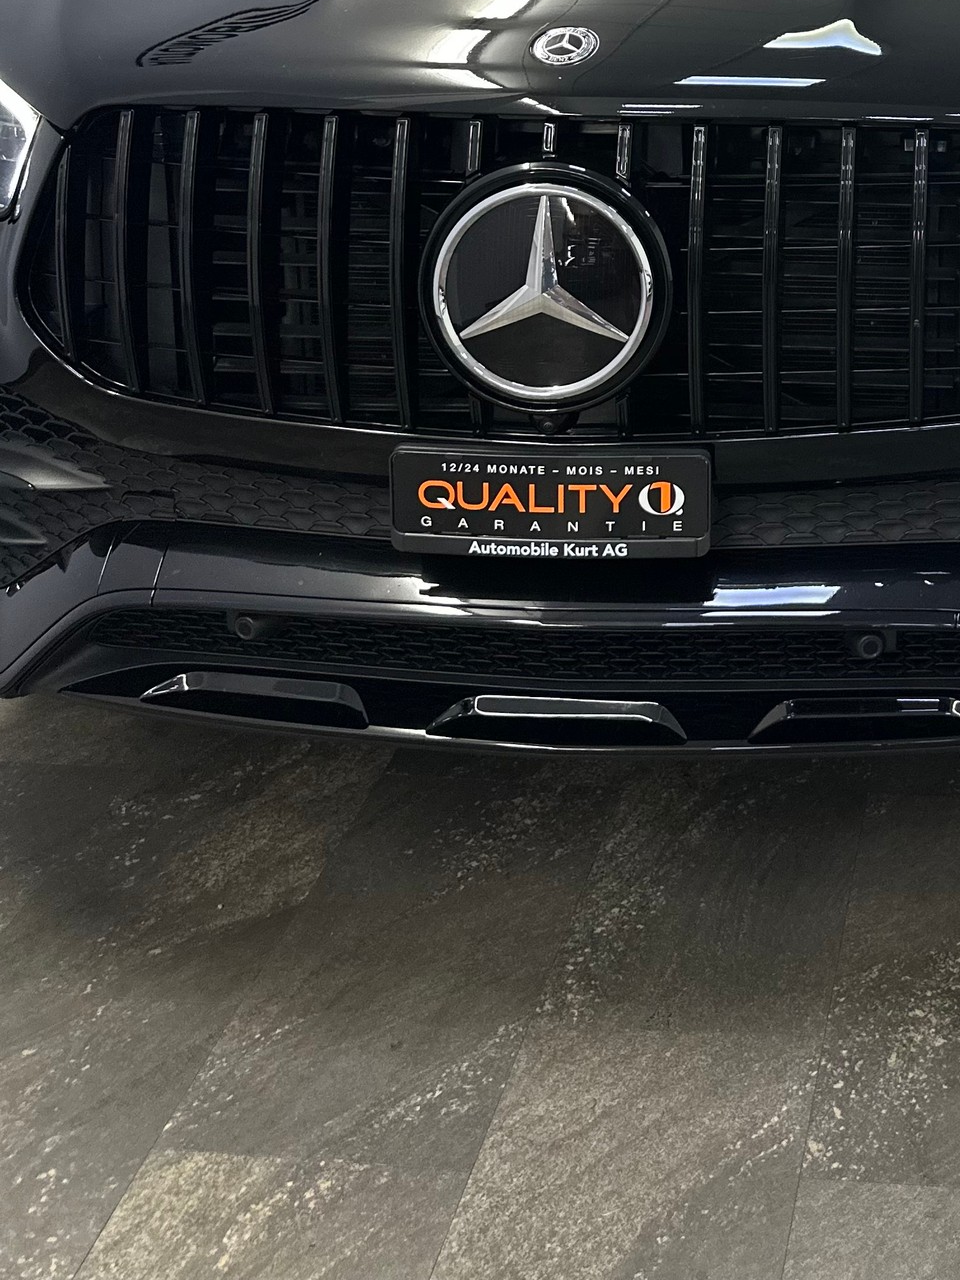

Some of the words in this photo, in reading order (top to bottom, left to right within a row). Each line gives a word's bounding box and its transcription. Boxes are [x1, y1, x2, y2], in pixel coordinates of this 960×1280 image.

[441, 463, 480, 473] 12/24
[487, 464, 546, 475] MONATE
[566, 466, 603, 475] MOIS
[624, 466, 660, 475] MESI
[418, 480, 633, 513] QUALITY
[420, 516, 683, 532] GARANTIE
[468, 540, 559, 556] Automobile
[563, 543, 599, 557] Kurt
[602, 543, 628, 557] AG
